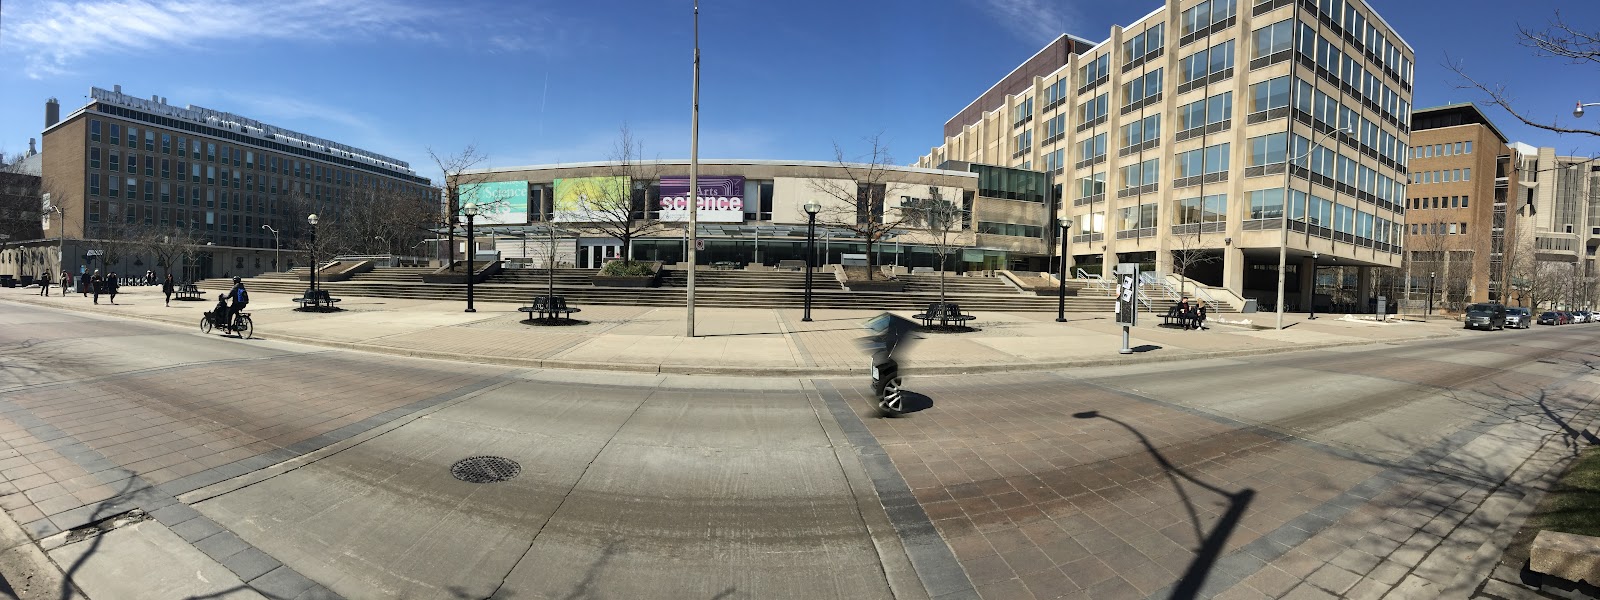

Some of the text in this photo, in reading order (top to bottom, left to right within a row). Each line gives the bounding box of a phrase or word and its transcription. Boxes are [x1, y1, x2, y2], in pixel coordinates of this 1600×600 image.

[485, 186, 527, 198] Science
[697, 186, 719, 196] Arts
[662, 191, 742, 211] science
